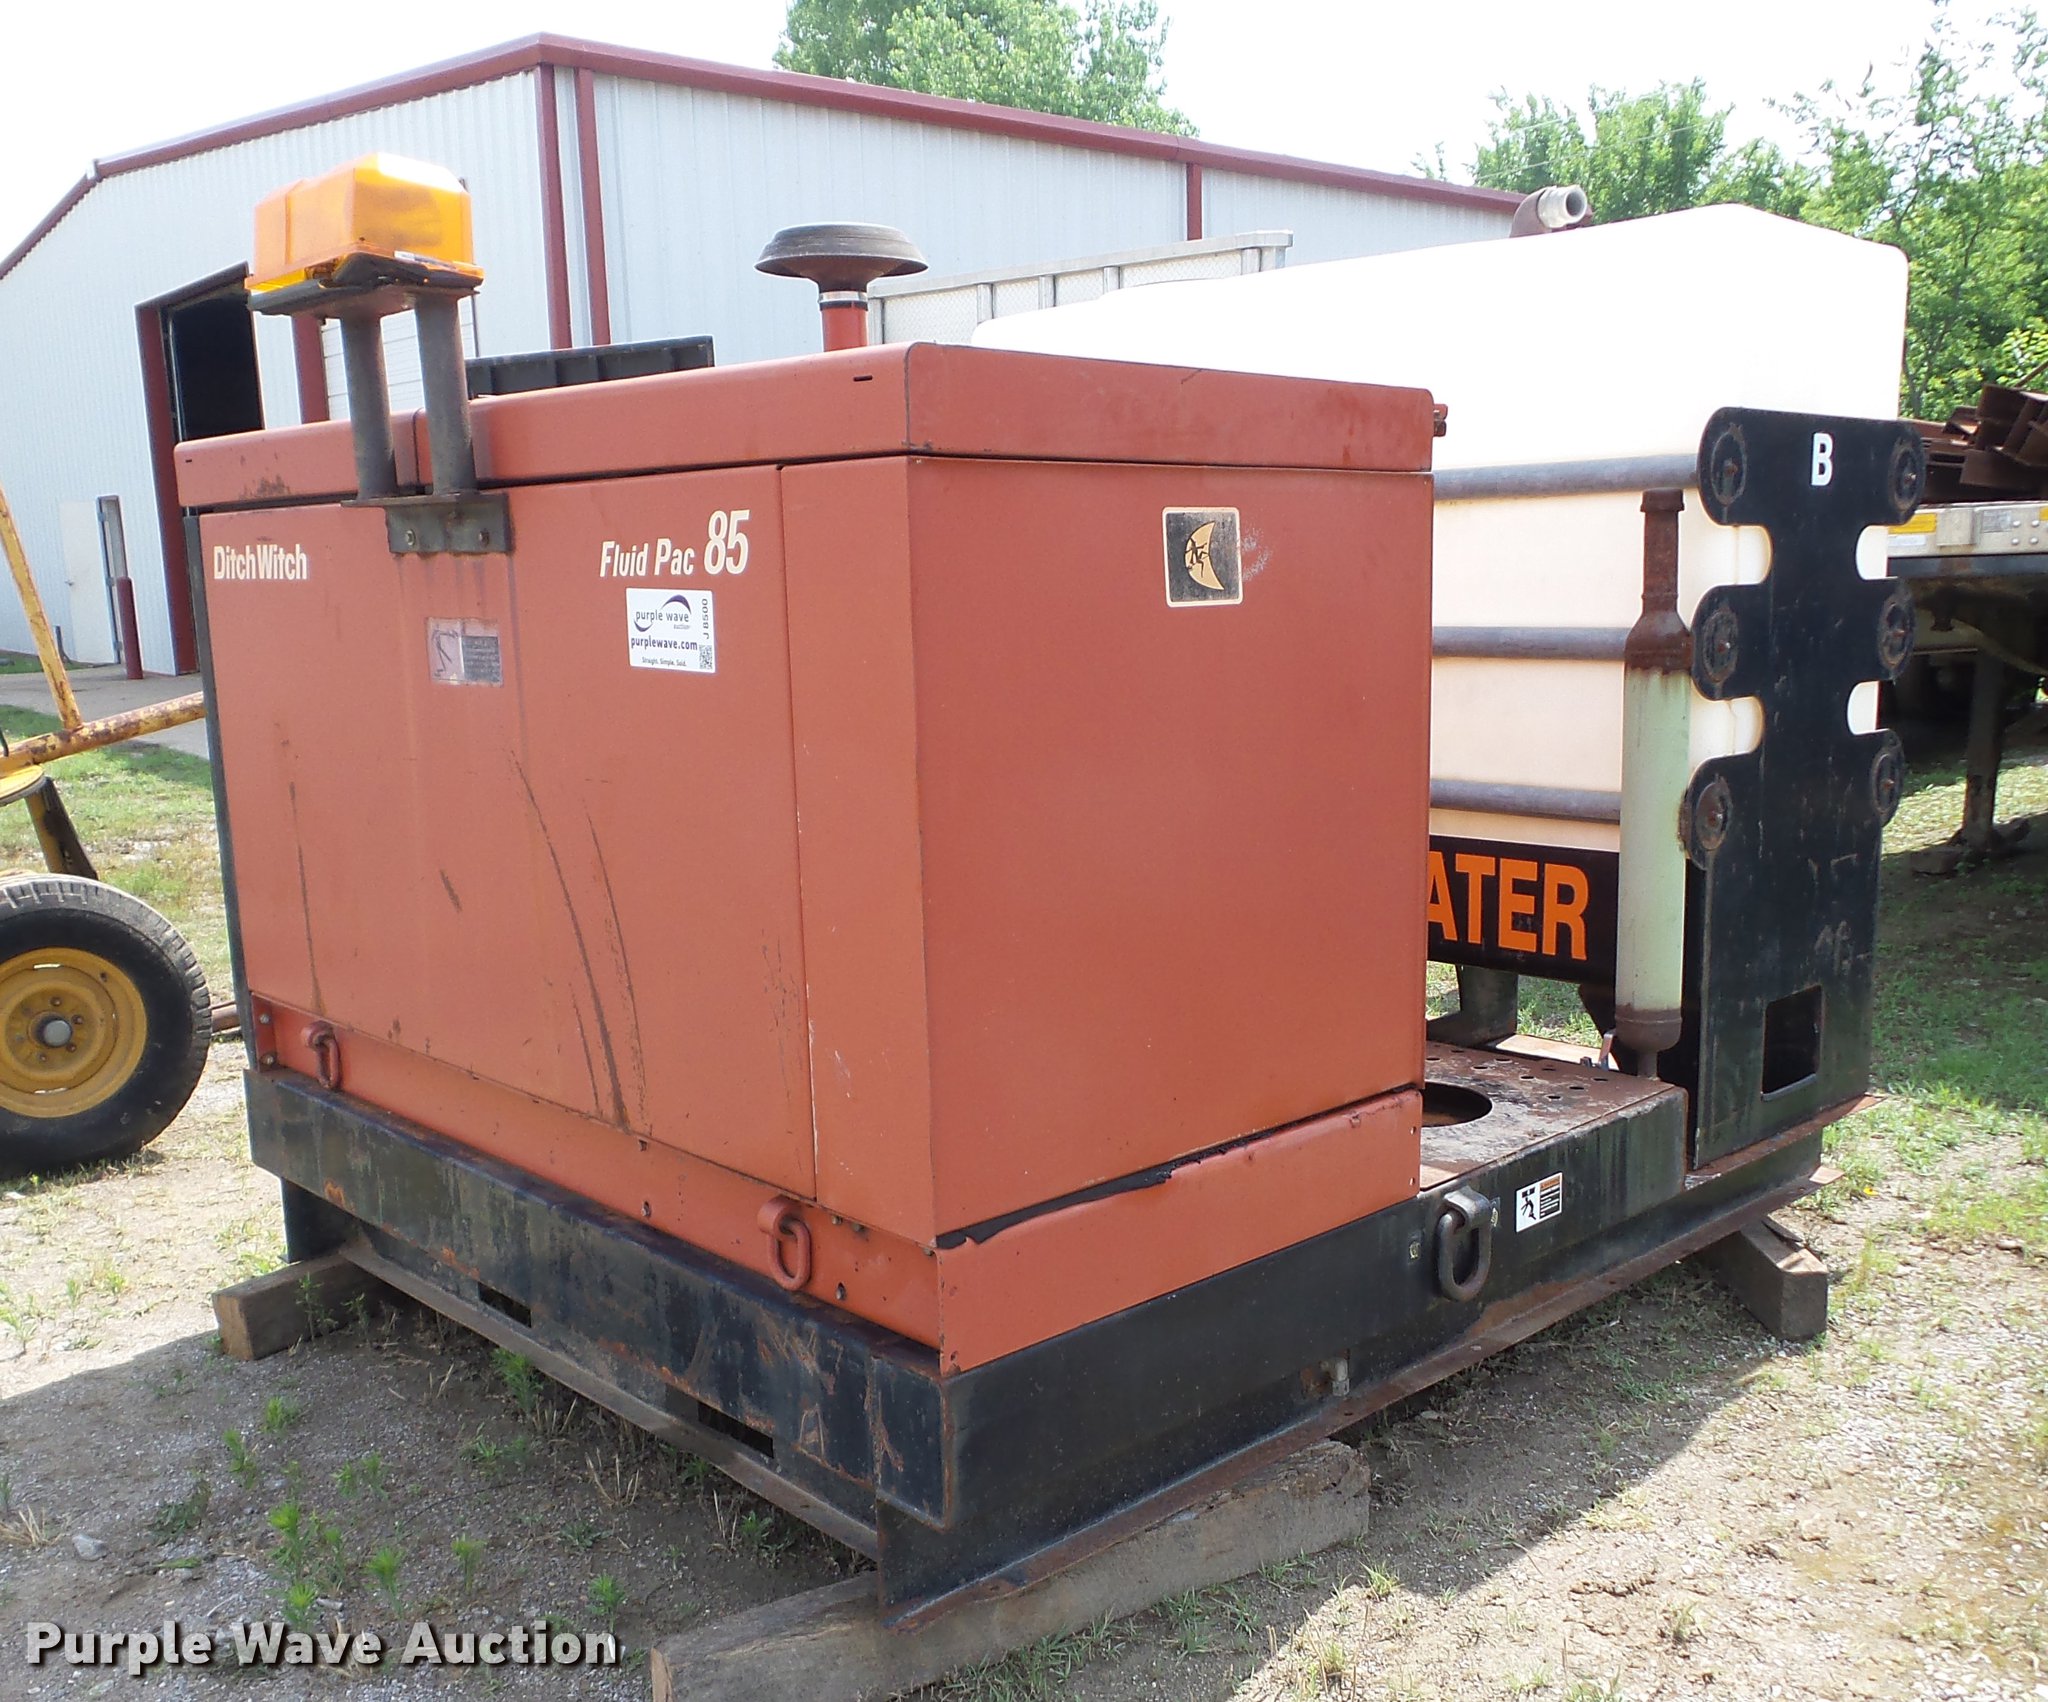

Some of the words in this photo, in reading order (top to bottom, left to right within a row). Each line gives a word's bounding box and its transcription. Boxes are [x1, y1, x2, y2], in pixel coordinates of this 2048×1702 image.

[1811, 432, 1833, 486] B
[600, 541, 648, 577] Fluid
[654, 538, 695, 575] Pac
[704, 510, 750, 574] 85
[631, 635, 698, 650] purplewave.com
[636, 609, 663, 623] purple
[666, 613, 689, 622] wave
[1427, 850, 1589, 961] ATER
